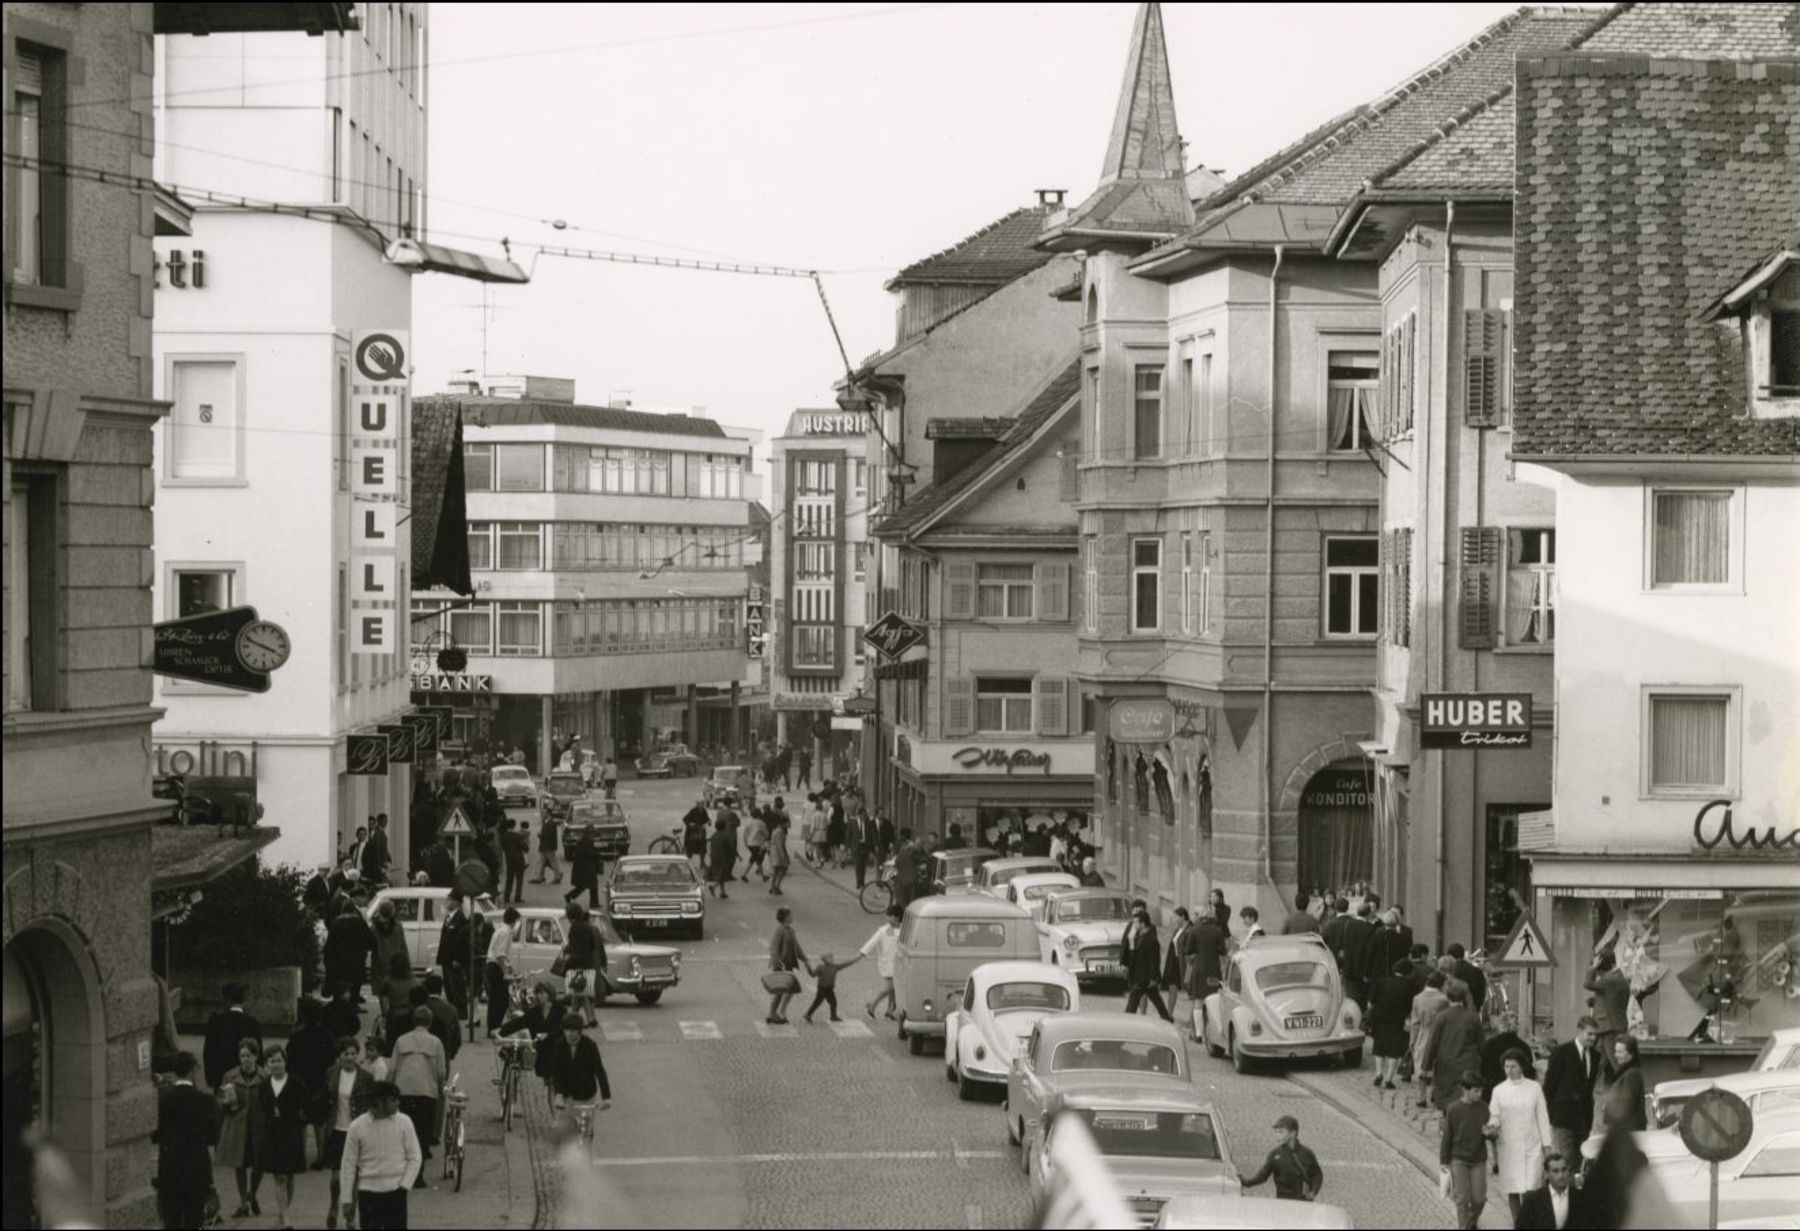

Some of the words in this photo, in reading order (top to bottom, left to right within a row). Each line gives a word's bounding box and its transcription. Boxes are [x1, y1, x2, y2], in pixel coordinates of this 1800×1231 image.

[355, 333, 407, 646] QUELLE
[748, 587, 761, 654] BANK
[867, 623, 913, 651] Agfa
[159, 648, 192, 657] UHREN
[204, 664, 234, 674] OPTIK
[408, 675, 491, 691] BANK
[1428, 700, 1525, 726] HUBER
